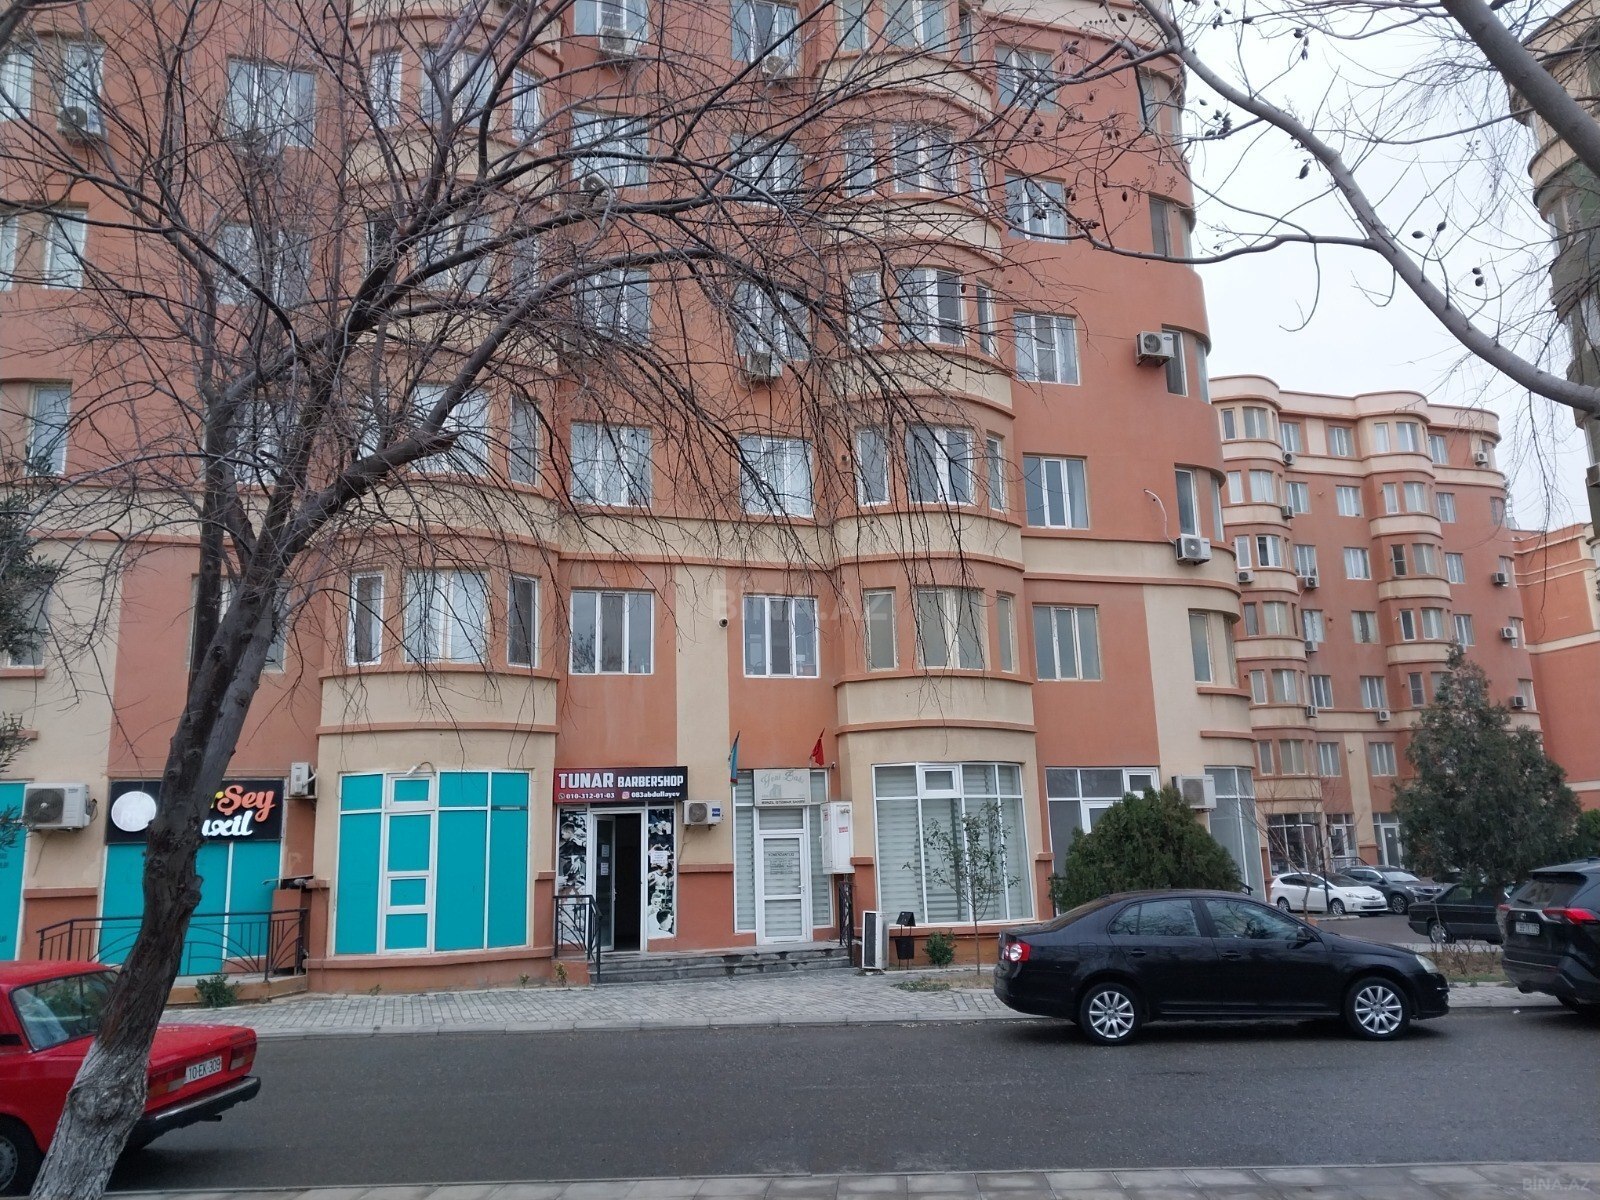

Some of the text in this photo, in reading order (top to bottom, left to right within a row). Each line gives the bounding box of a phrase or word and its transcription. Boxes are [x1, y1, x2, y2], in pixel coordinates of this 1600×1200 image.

[558, 772, 684, 789] TUNAR BARBERSHOP
[217, 784, 276, 823] Şey
[565, 792, 615, 800] 010-312-01-03
